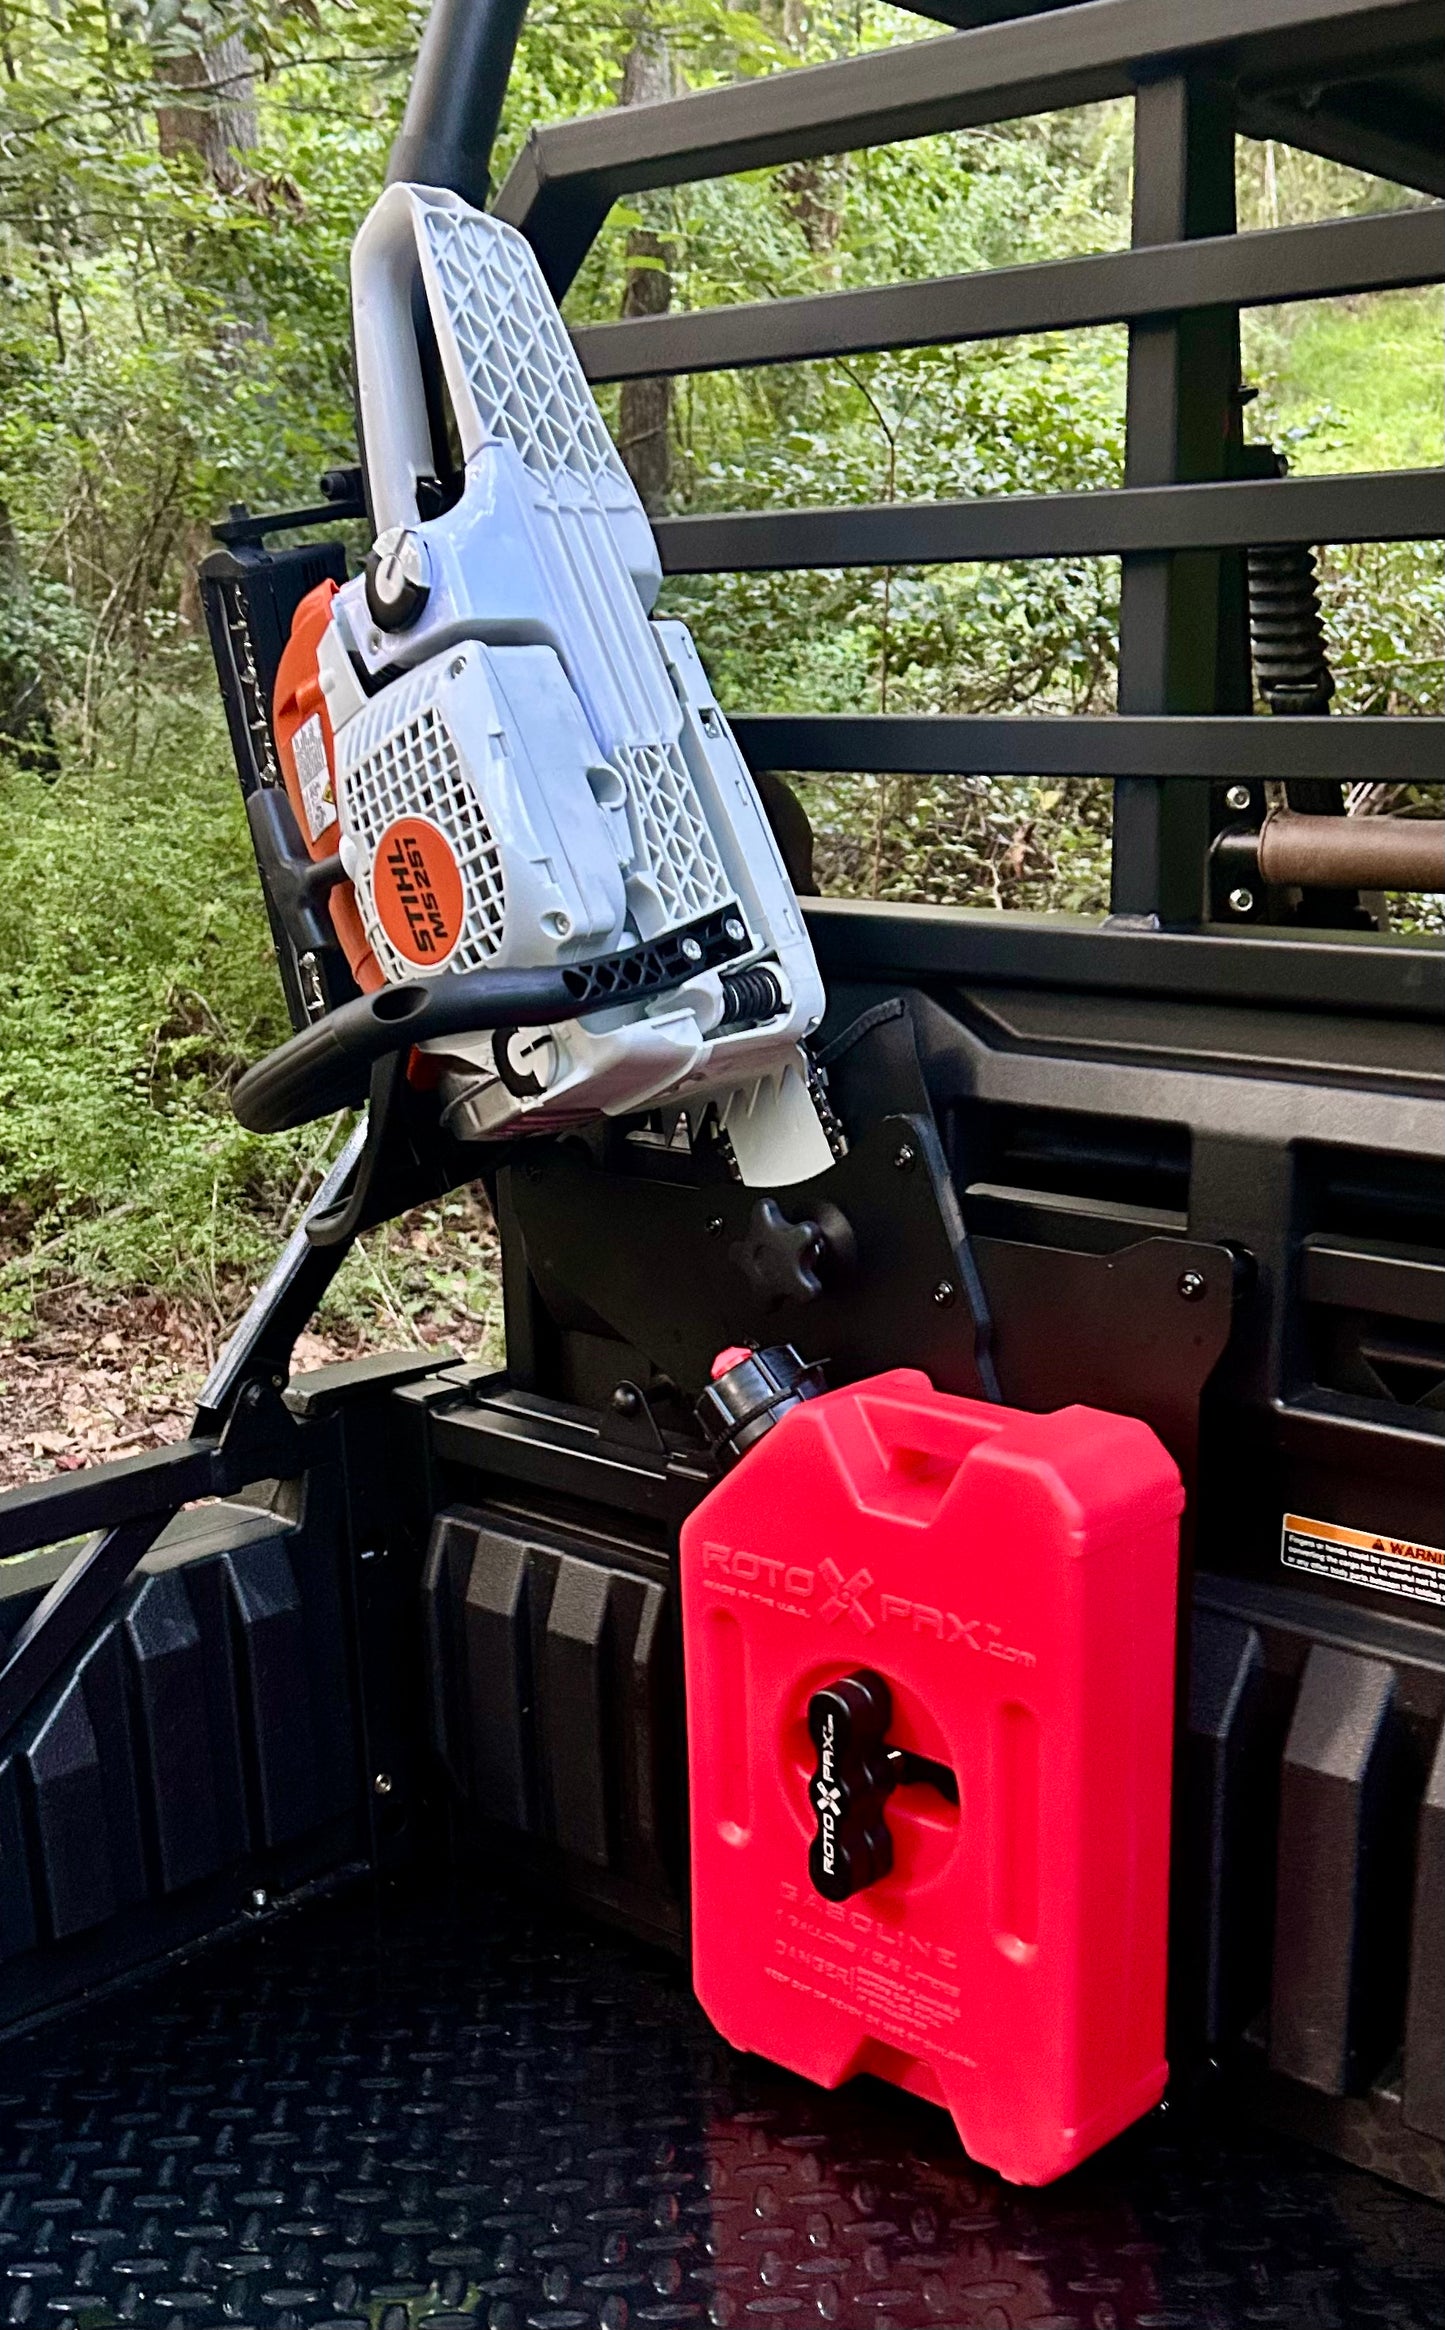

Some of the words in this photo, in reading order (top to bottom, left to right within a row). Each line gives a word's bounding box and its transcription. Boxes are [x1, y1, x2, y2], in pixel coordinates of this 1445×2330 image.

[403, 837, 431, 889] 251
[387, 838, 436, 953] STIHL
[421, 893, 448, 938] MS
[702, 1540, 815, 1598] ROTO
[1390, 1541, 1445, 1566] WARNI
[823, 1812, 835, 1875] ROTO
